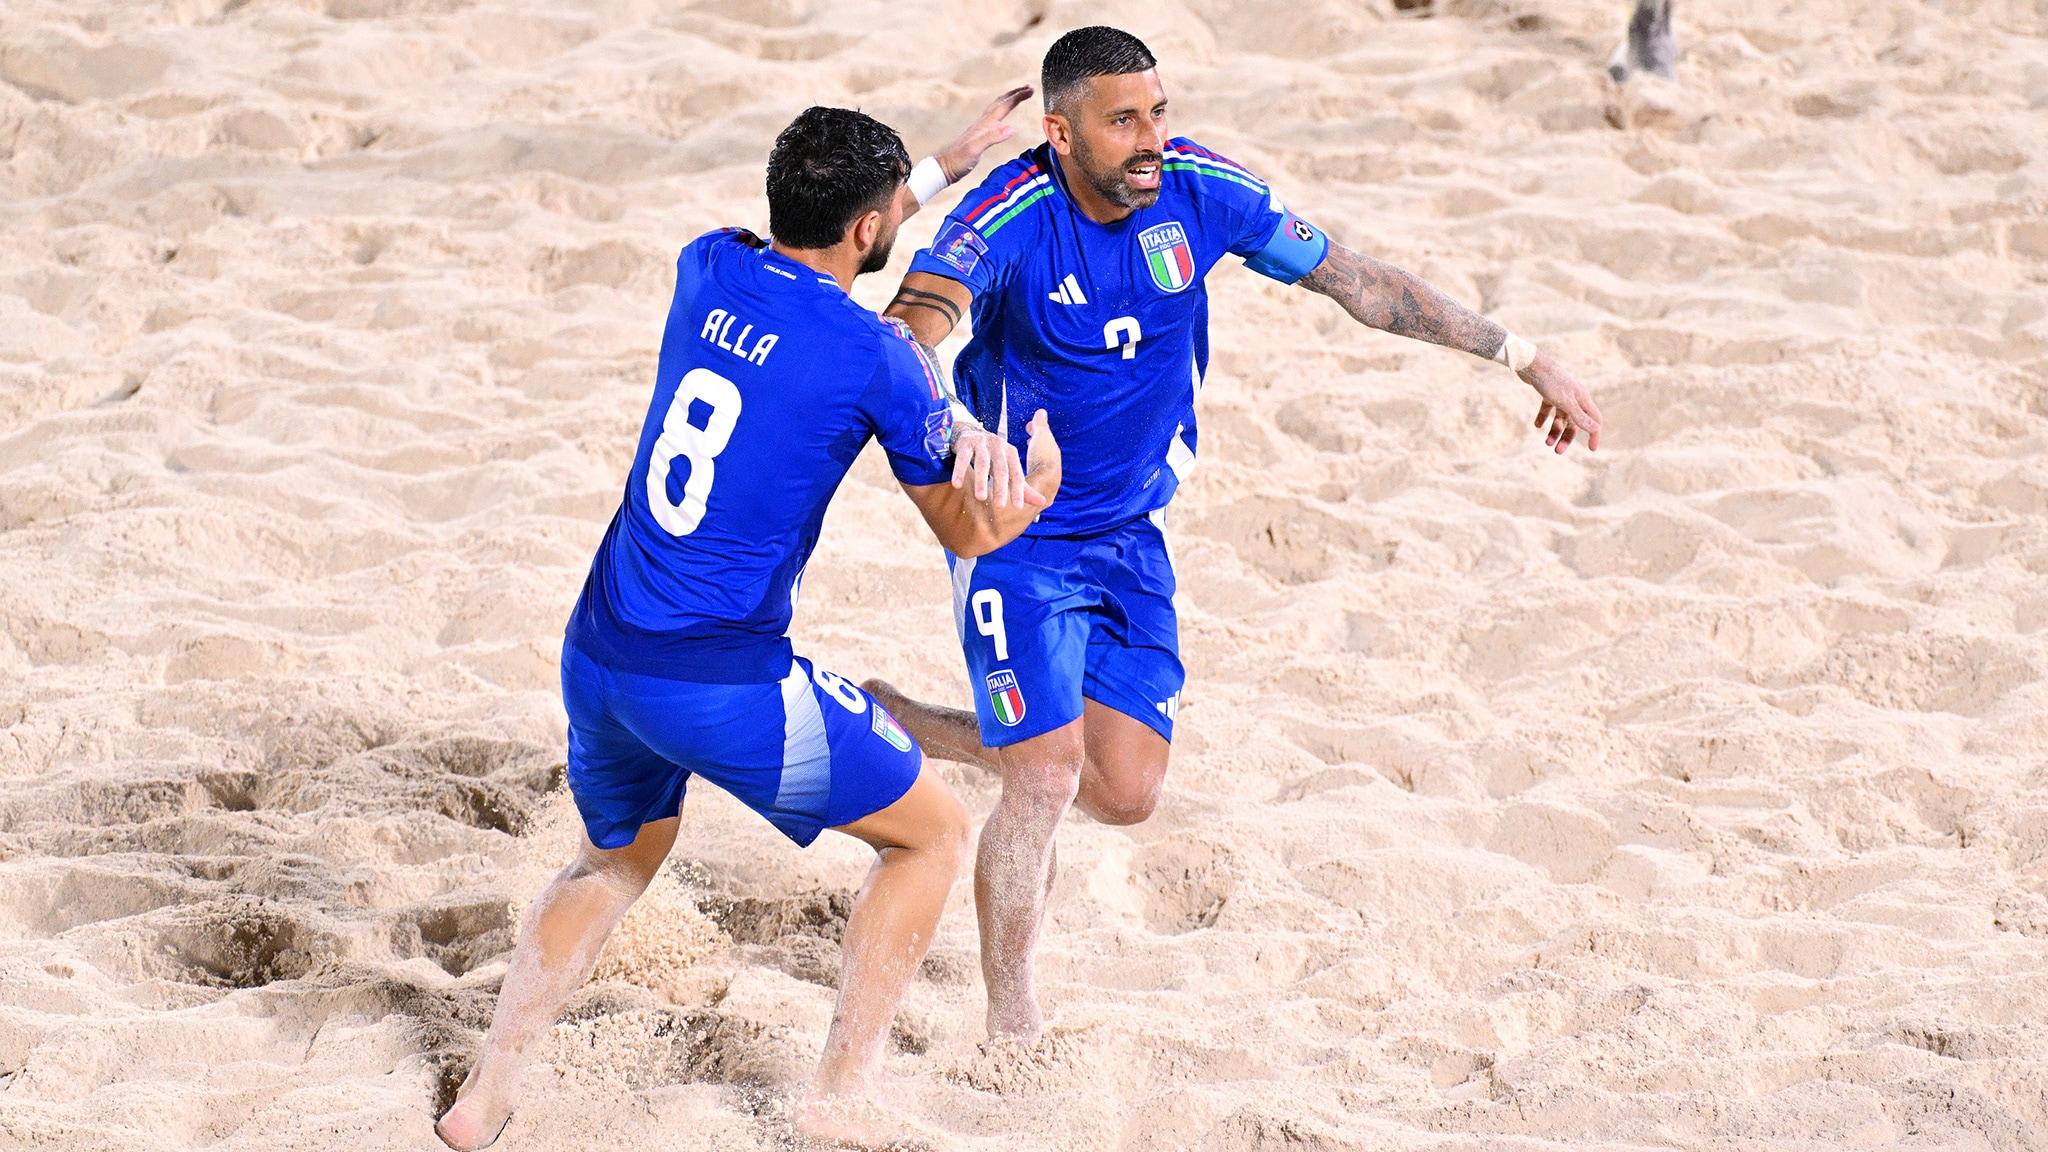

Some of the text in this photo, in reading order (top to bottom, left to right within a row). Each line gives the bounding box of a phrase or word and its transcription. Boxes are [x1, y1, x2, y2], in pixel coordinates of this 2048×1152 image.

[1142, 226, 1182, 249] ITALIA
[700, 308, 780, 366] ALLA
[646, 368, 742, 537] 8
[971, 588, 1009, 661] 9
[988, 673, 1014, 690] ITALIA
